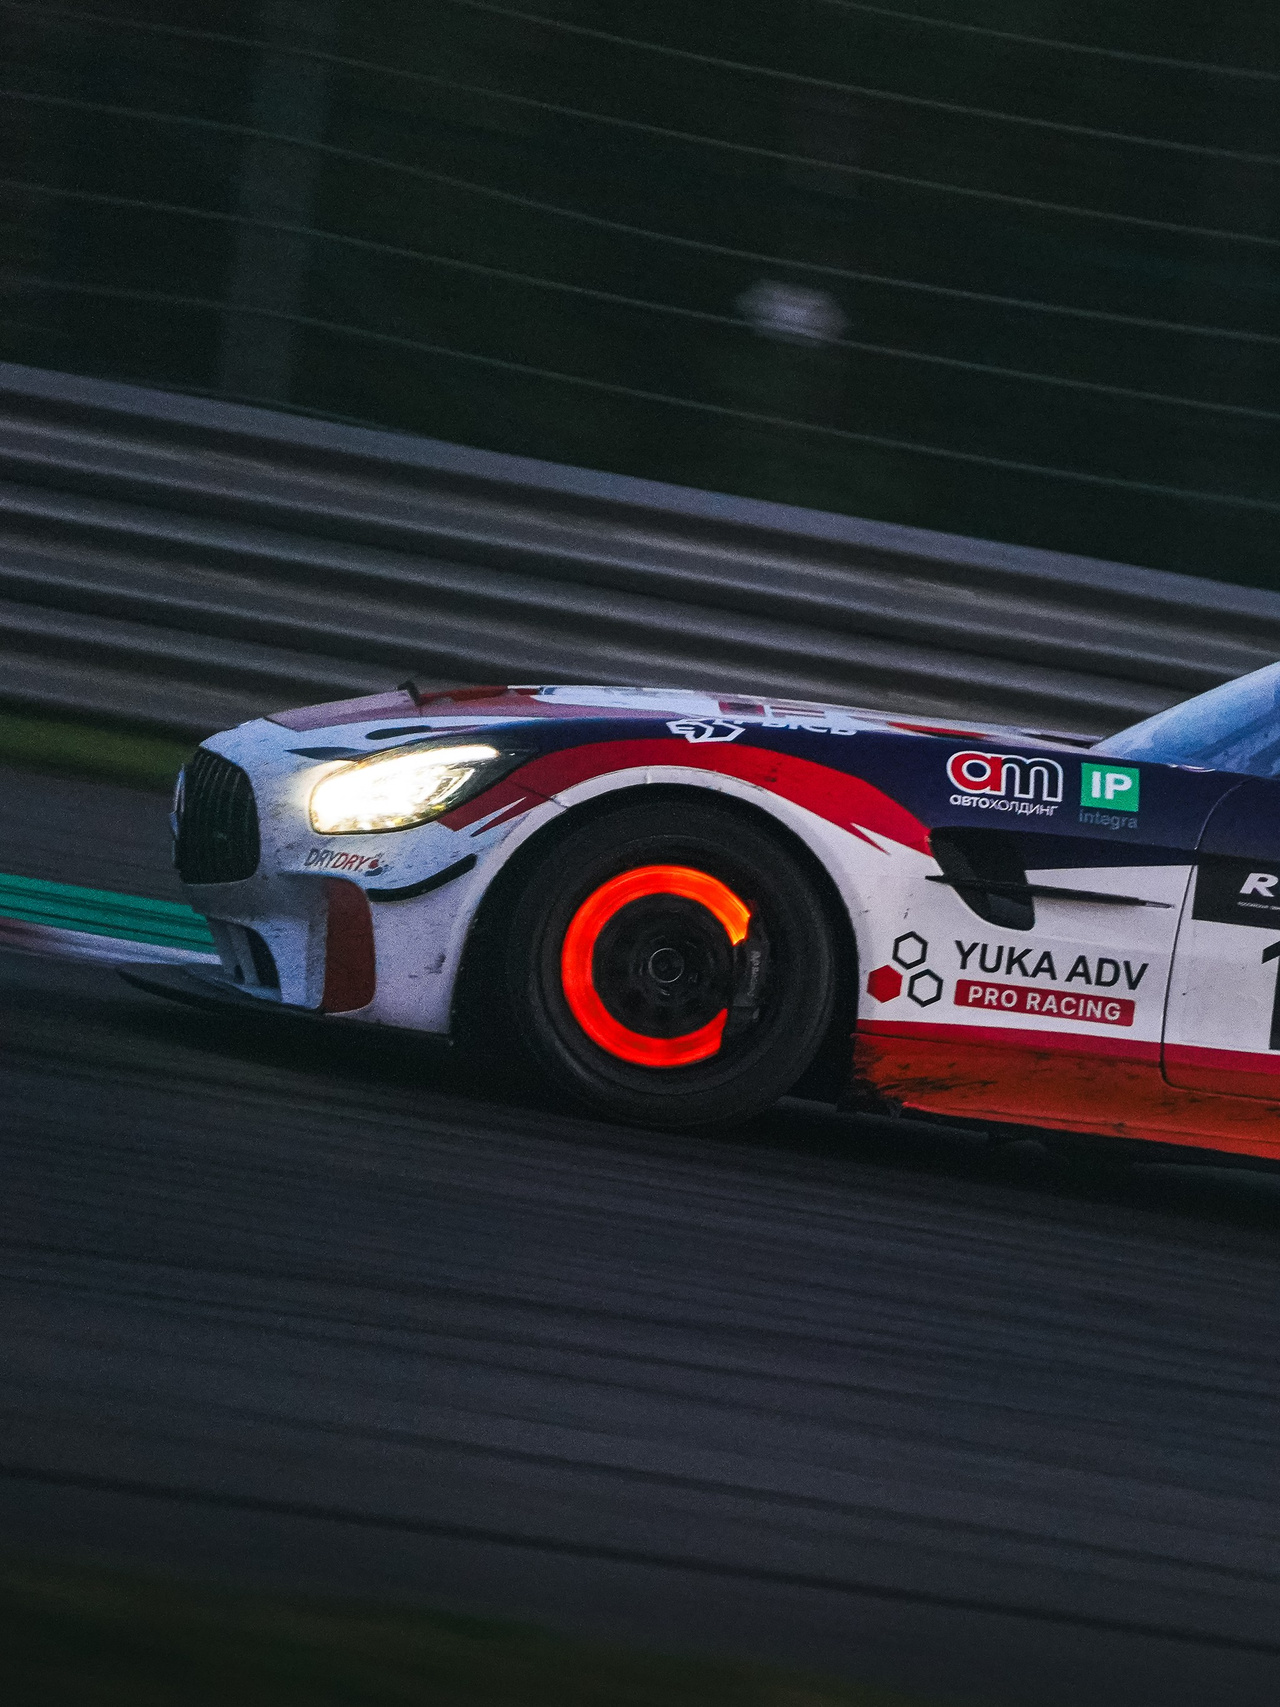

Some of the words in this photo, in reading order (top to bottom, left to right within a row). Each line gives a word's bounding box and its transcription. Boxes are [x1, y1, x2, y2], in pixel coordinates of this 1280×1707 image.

[1091, 770, 1133, 801] IP
[949, 793, 1060, 817] автохолдинг
[1078, 808, 1140, 831] integra
[954, 939, 1058, 981] YUKA
[1064, 954, 1150, 991] ADV
[967, 985, 1019, 1009] PRO
[1025, 991, 1122, 1022] RACING
